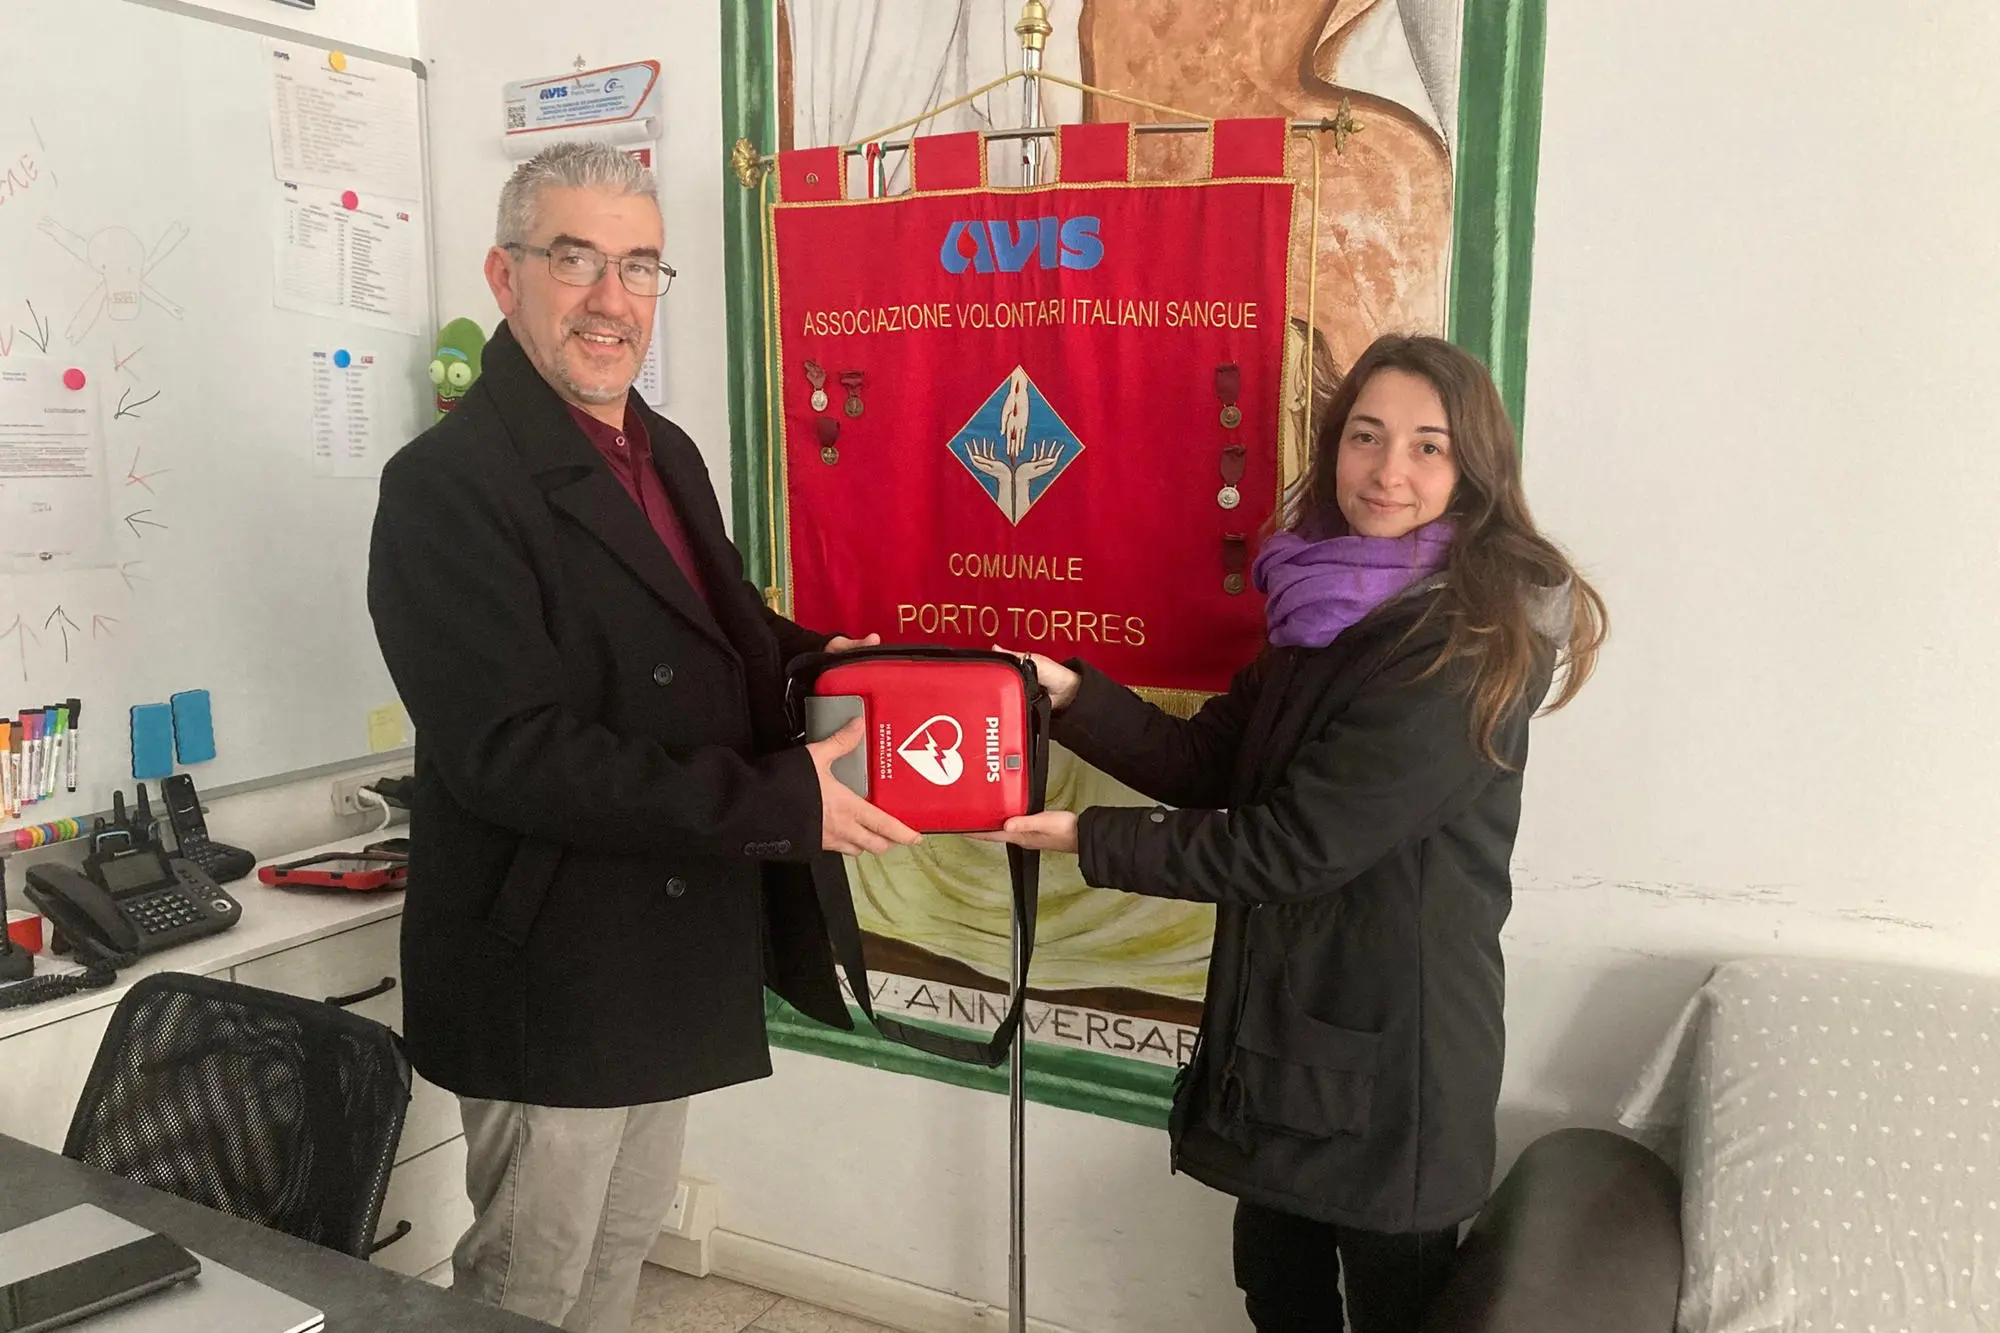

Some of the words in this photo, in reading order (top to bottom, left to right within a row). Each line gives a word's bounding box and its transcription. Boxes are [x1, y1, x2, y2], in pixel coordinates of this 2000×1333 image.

[540, 86, 568, 100] AVIS
[939, 216, 1104, 274] AVIS
[803, 302, 952, 337] ASSOCIAZIONE
[956, 299, 1065, 329] VOLONTARI
[1072, 299, 1159, 328] ITALIANI
[1165, 301, 1258, 329] SANGUE
[949, 552, 1083, 581] COMUNALE
[897, 603, 1000, 637] PORTO
[1007, 607, 1146, 646] TORRES
[985, 716, 1000, 783] PHILIPS
